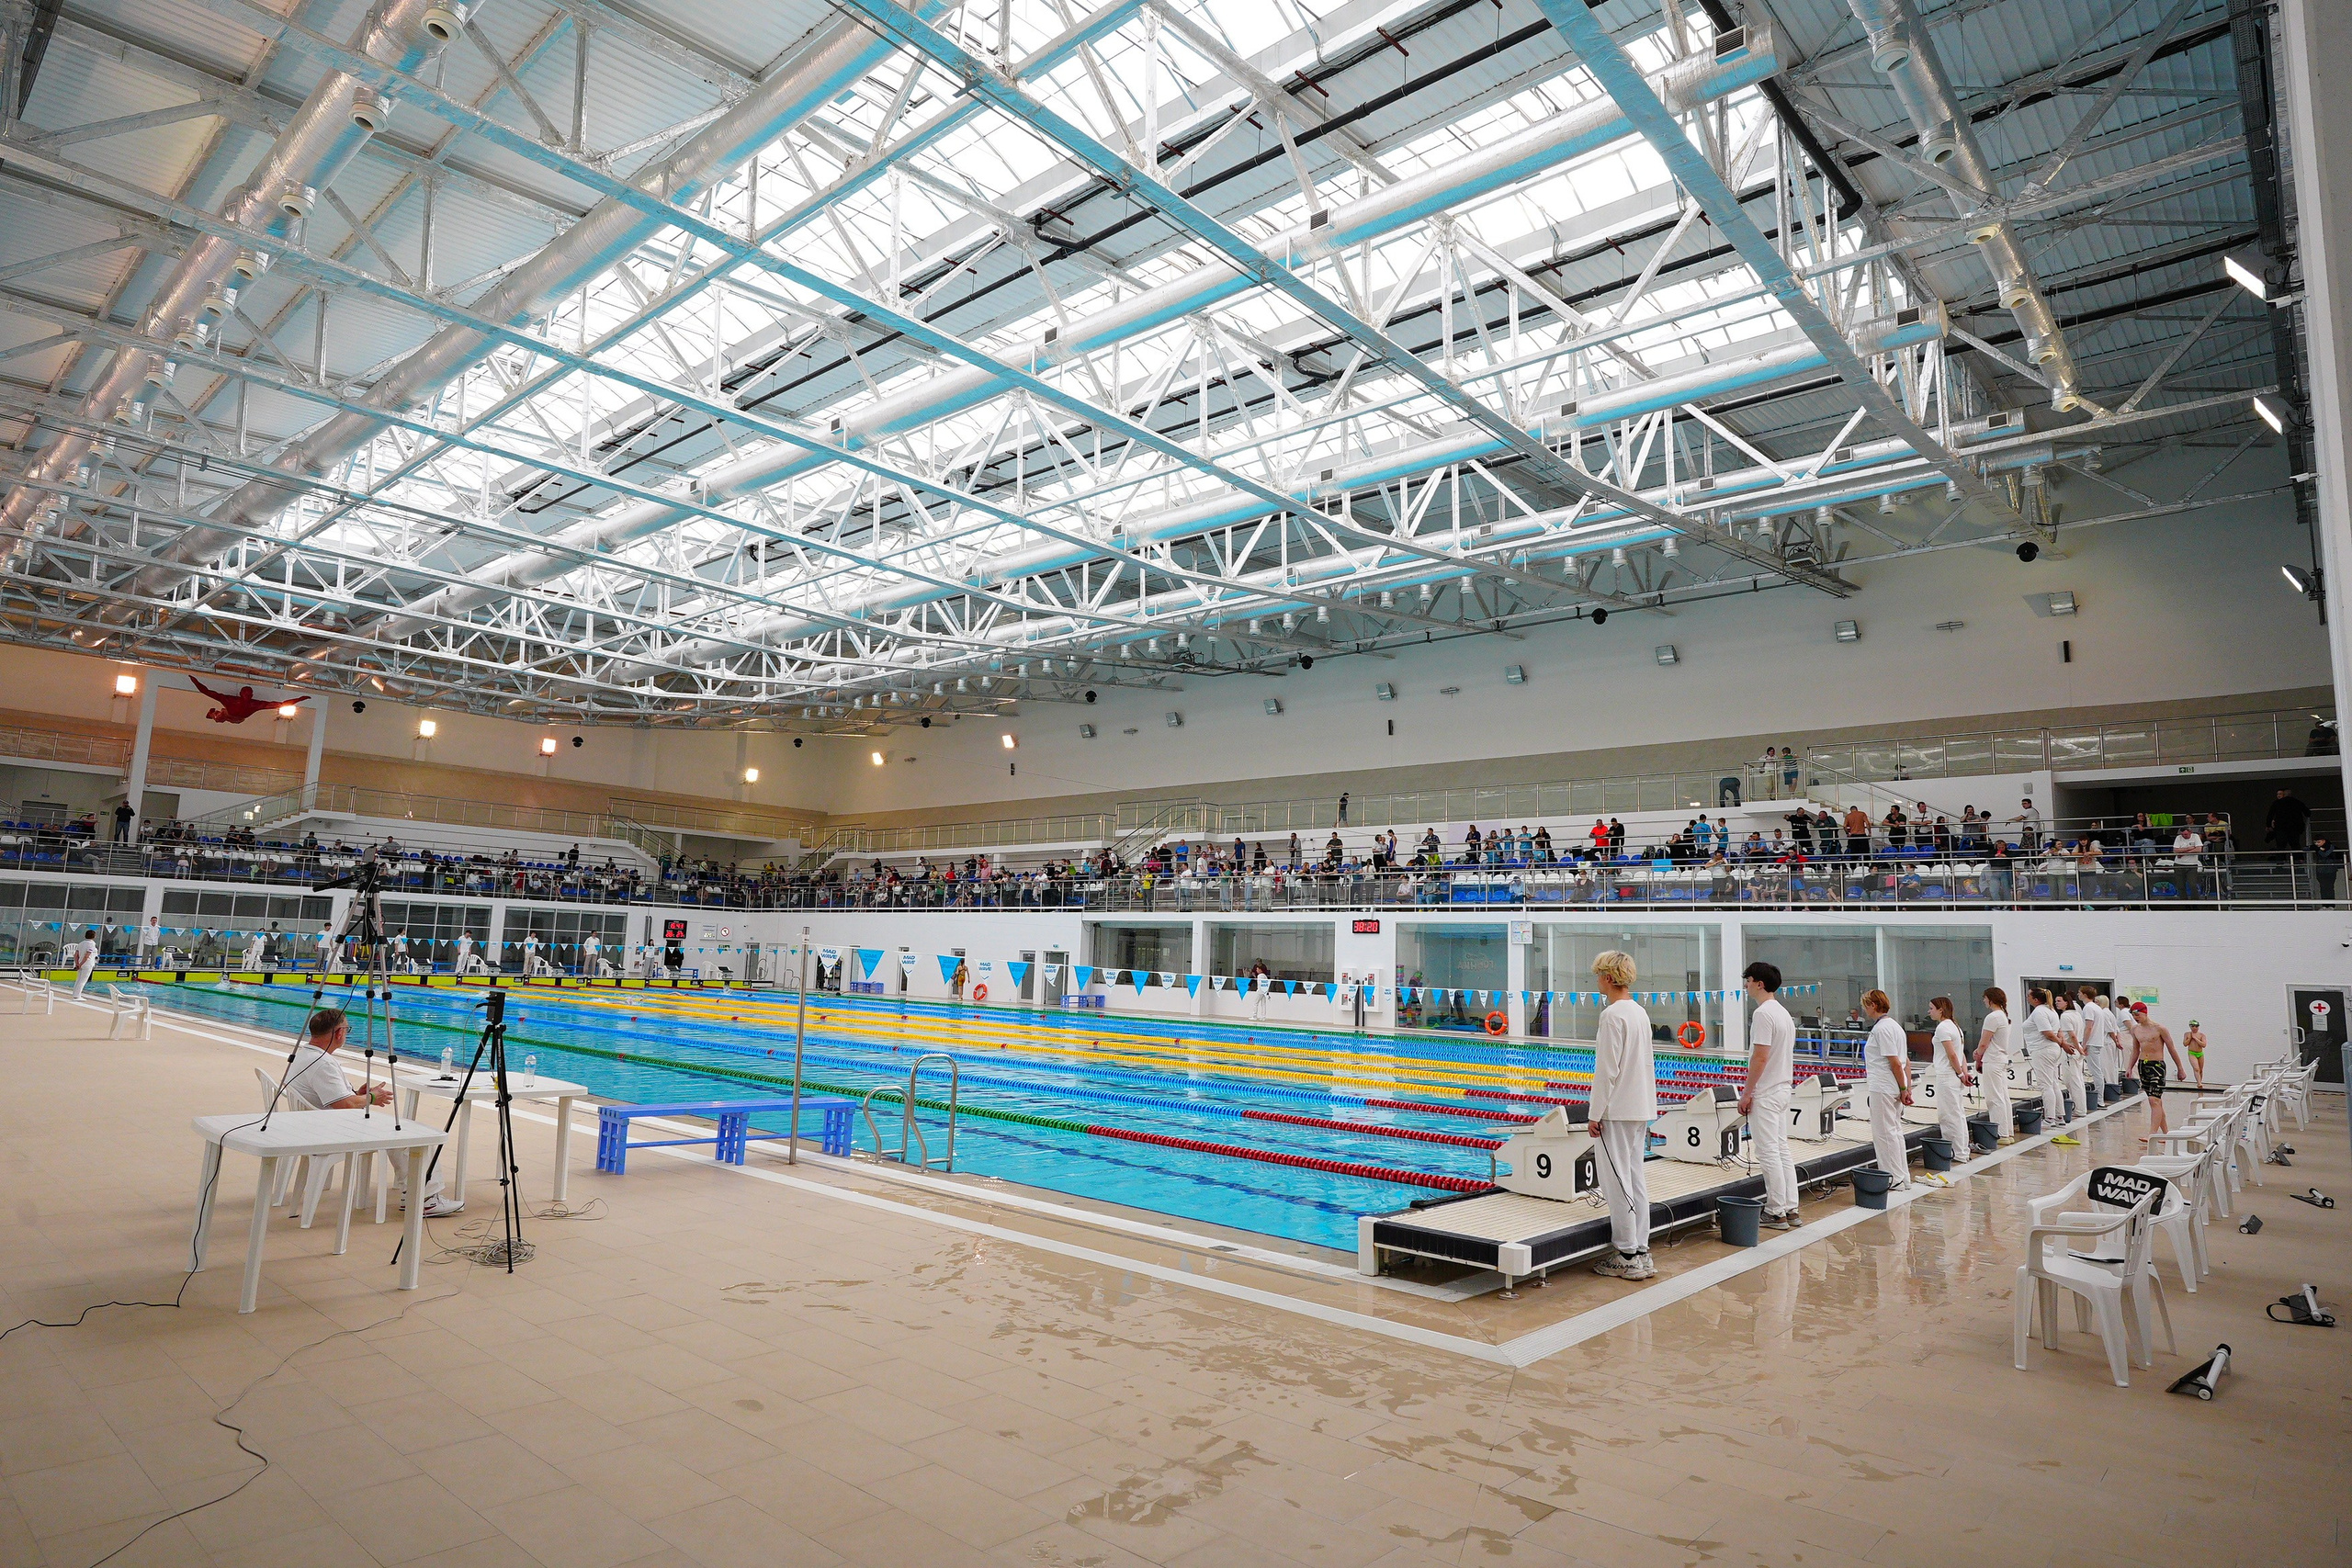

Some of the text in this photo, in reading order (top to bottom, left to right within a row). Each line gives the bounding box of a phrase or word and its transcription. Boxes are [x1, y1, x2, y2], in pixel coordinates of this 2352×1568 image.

[1353, 921, 1378, 932] 38:20
[1971, 1076, 1980, 1088] 4
[2007, 1069, 2016, 1080] 3
[1925, 1084, 1935, 1098] 5
[1790, 1108, 1802, 1125] 7
[1824, 1113, 1829, 1131] 7
[1687, 1126, 1701, 1147] 8
[1727, 1132, 1734, 1153] 8
[1536, 1153, 1552, 1179] 9
[1585, 1160, 1594, 1187] 9
[2103, 1172, 2151, 1192] MAD
